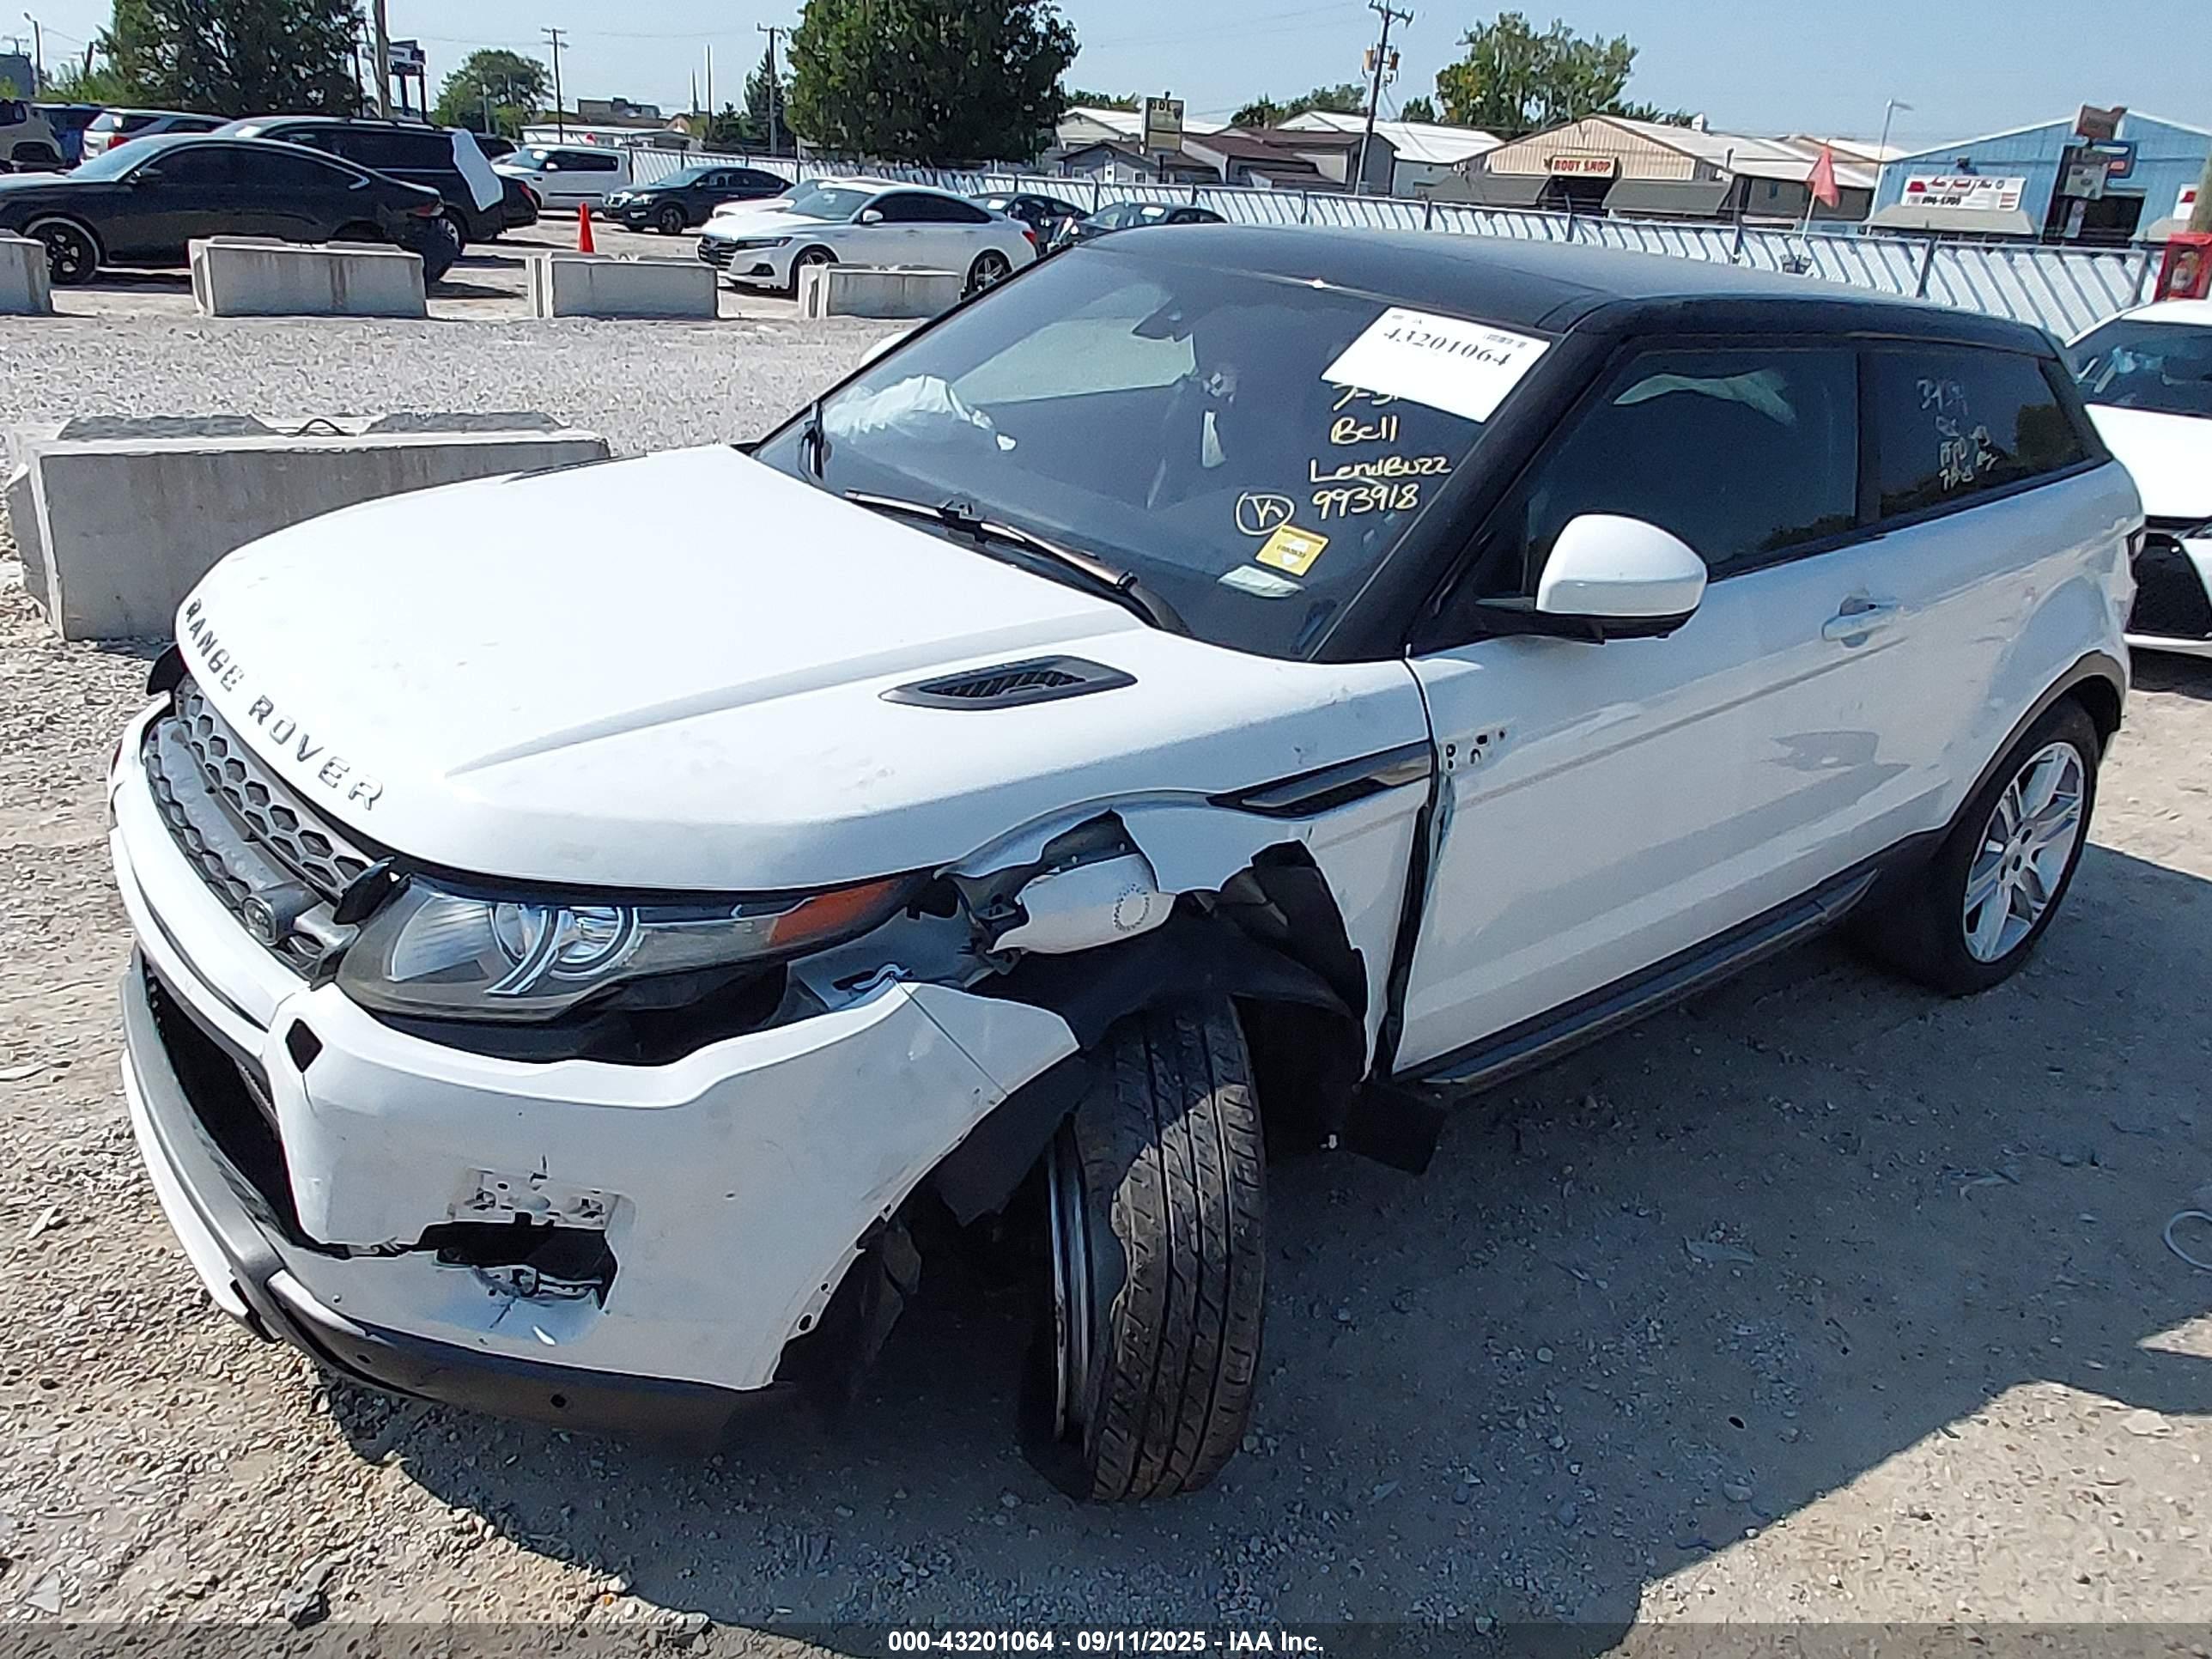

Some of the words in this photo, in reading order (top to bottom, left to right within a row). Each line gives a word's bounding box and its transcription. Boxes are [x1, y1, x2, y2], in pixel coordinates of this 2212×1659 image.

[1311, 483, 1419, 520] 993918
[185, 599, 245, 692] RANGE
[248, 695, 383, 811] ROVER
